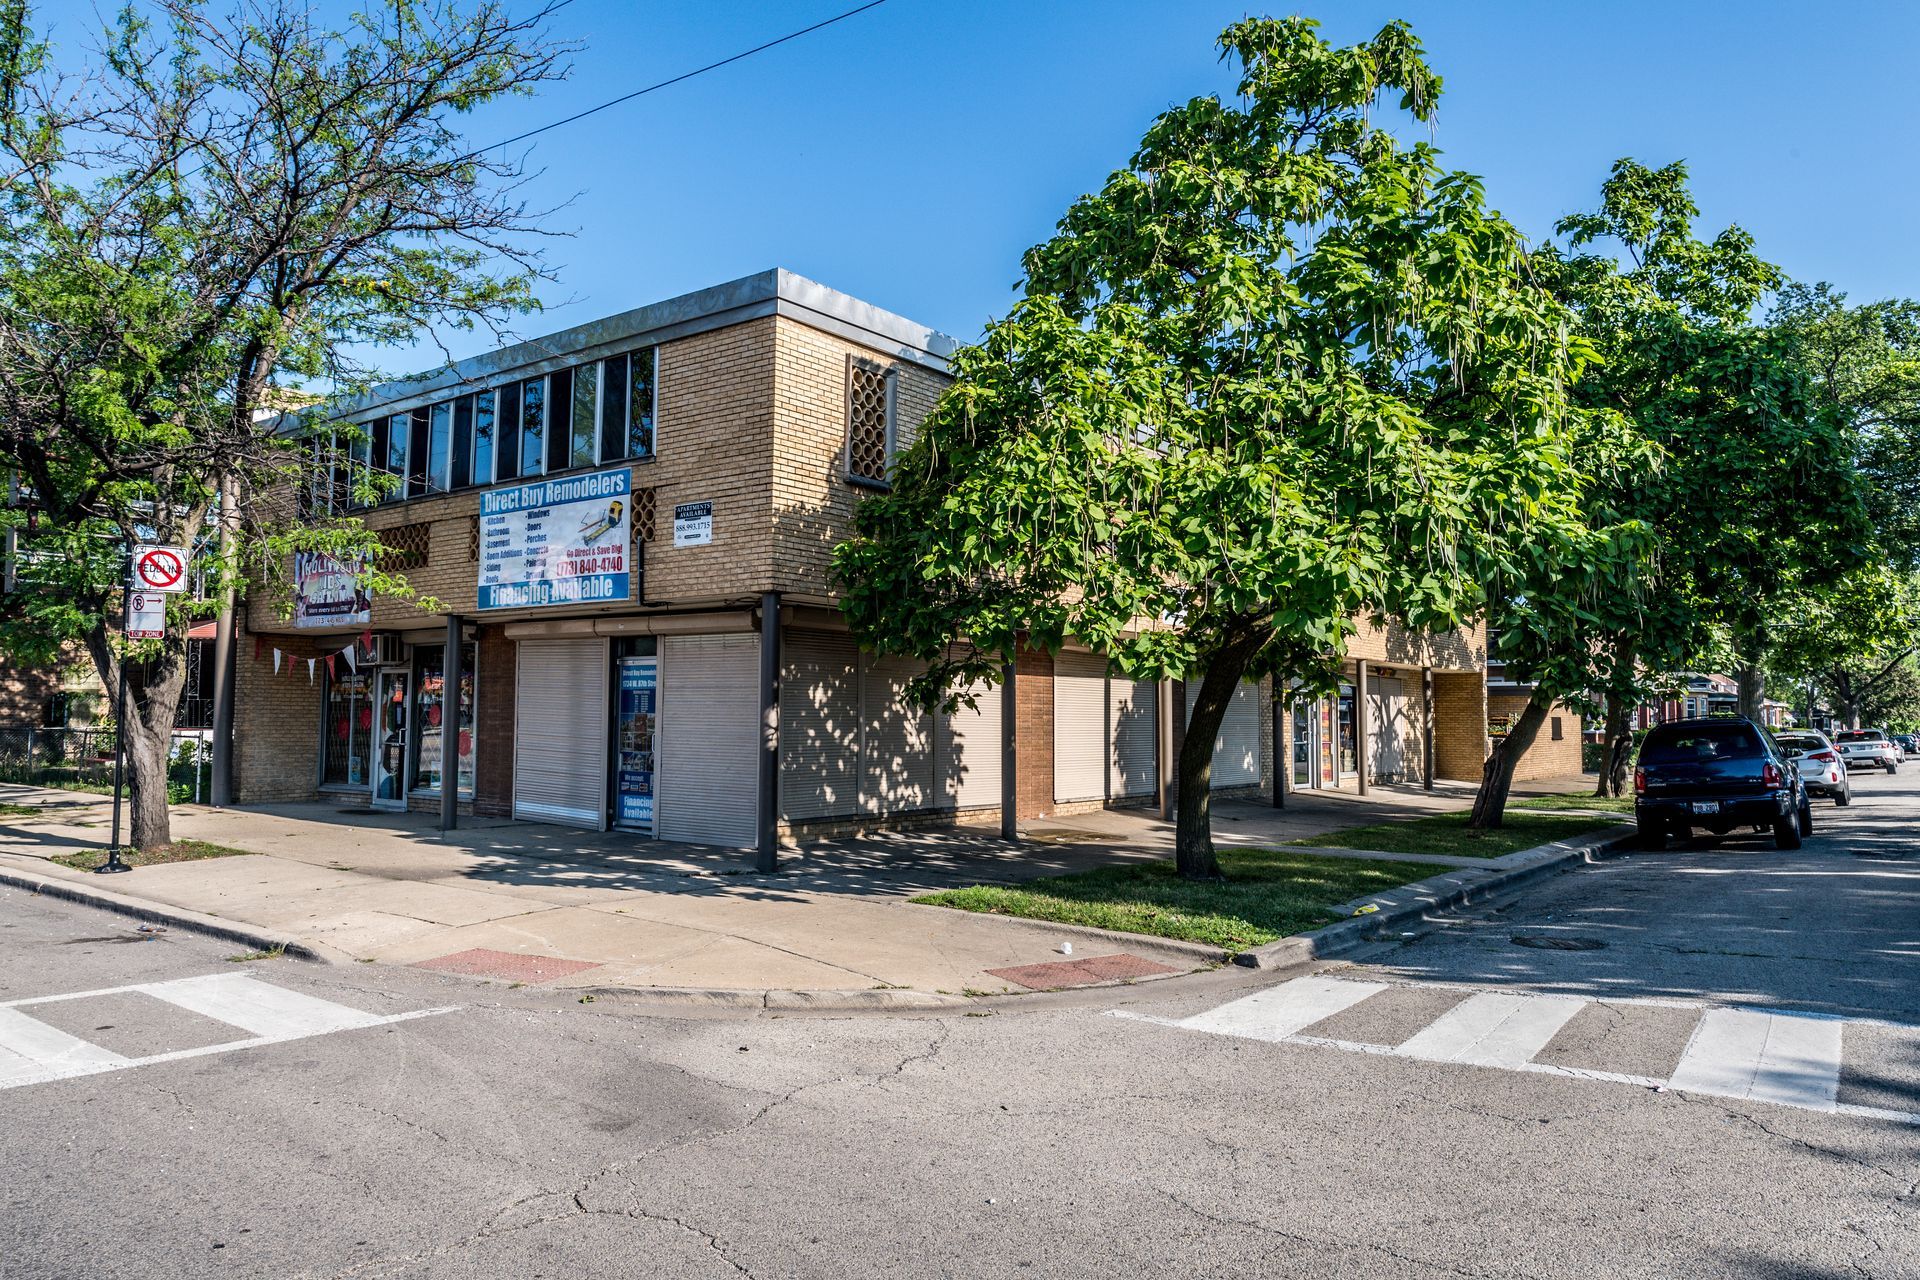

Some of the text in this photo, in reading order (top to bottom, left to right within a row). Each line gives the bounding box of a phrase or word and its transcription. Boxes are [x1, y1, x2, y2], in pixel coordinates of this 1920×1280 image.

[484, 474, 624, 512] Direct Buy Remodelers
[677, 503, 710, 512] APARTMENTS
[528, 510, 550, 519] Windows
[680, 510, 707, 518] AVAILABLE
[488, 517, 505, 525] Kitchen
[528, 523, 541, 531] Doors
[488, 528, 509, 537] Bathroom
[527, 534, 546, 543] Porches
[488, 539, 510, 548] Basement
[500, 549, 522, 558] Additions
[527, 546, 548, 555] Concrete
[567, 550, 573, 558] Go
[575, 548, 590, 557] Direct
[597, 546, 610, 555] Save
[612, 544, 622, 554] Big!
[486, 563, 501, 571] Siding
[526, 559, 546, 567] Painting
[557, 556, 622, 576] (773) 840-4740
[490, 576, 613, 605] Financing Available
